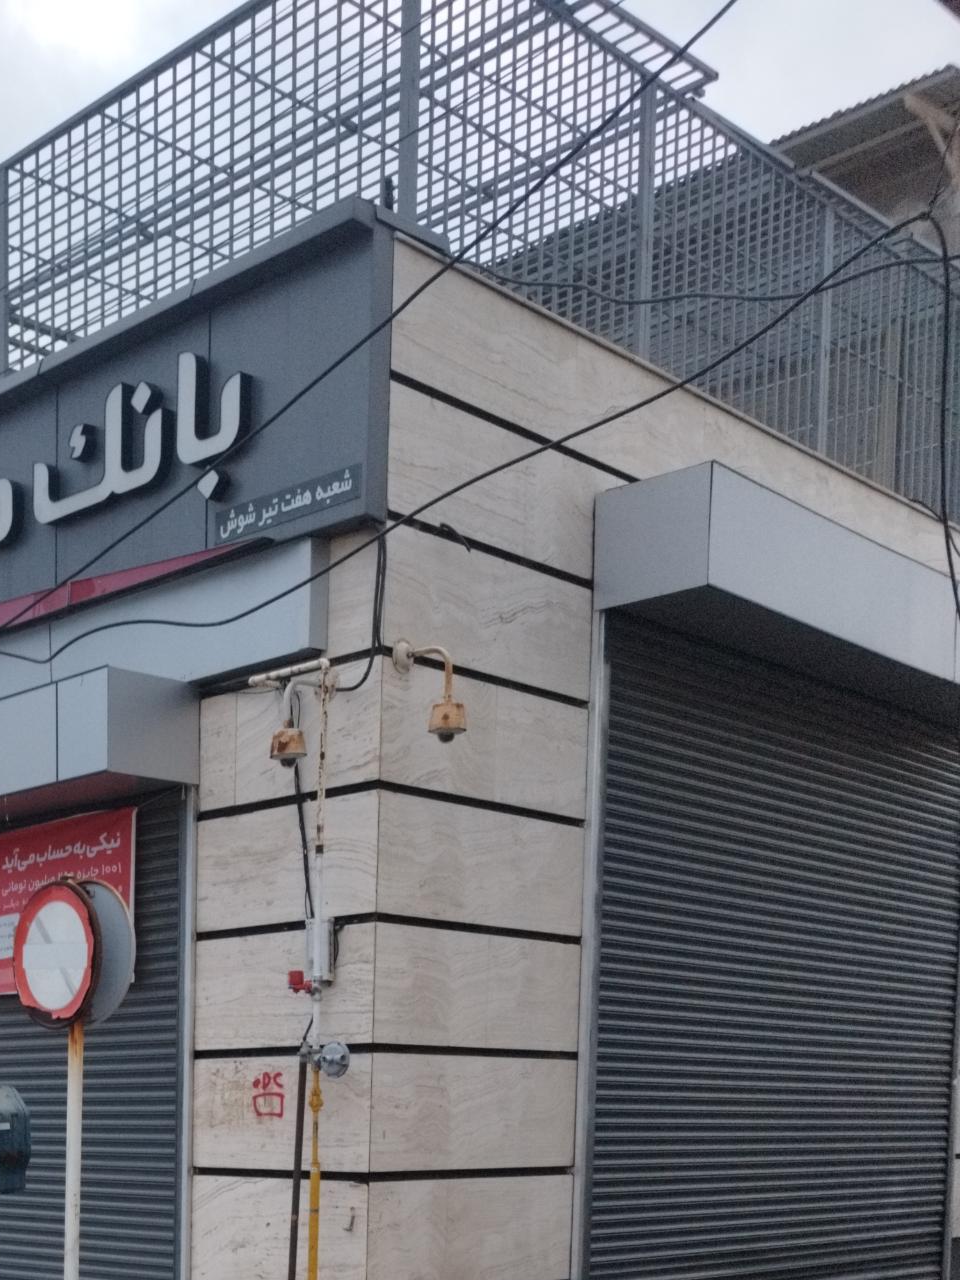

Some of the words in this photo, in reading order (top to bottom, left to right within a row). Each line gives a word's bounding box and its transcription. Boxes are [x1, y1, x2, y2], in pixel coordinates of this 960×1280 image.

[315, 468, 352, 504] شعبه
[258, 497, 279, 527] تیر
[281, 489, 312, 512] هفت
[220, 503, 256, 538] شوش
[36, 844, 72, 867] حساب
[73, 841, 86, 859] به
[86, 832, 121, 858] نیکی
